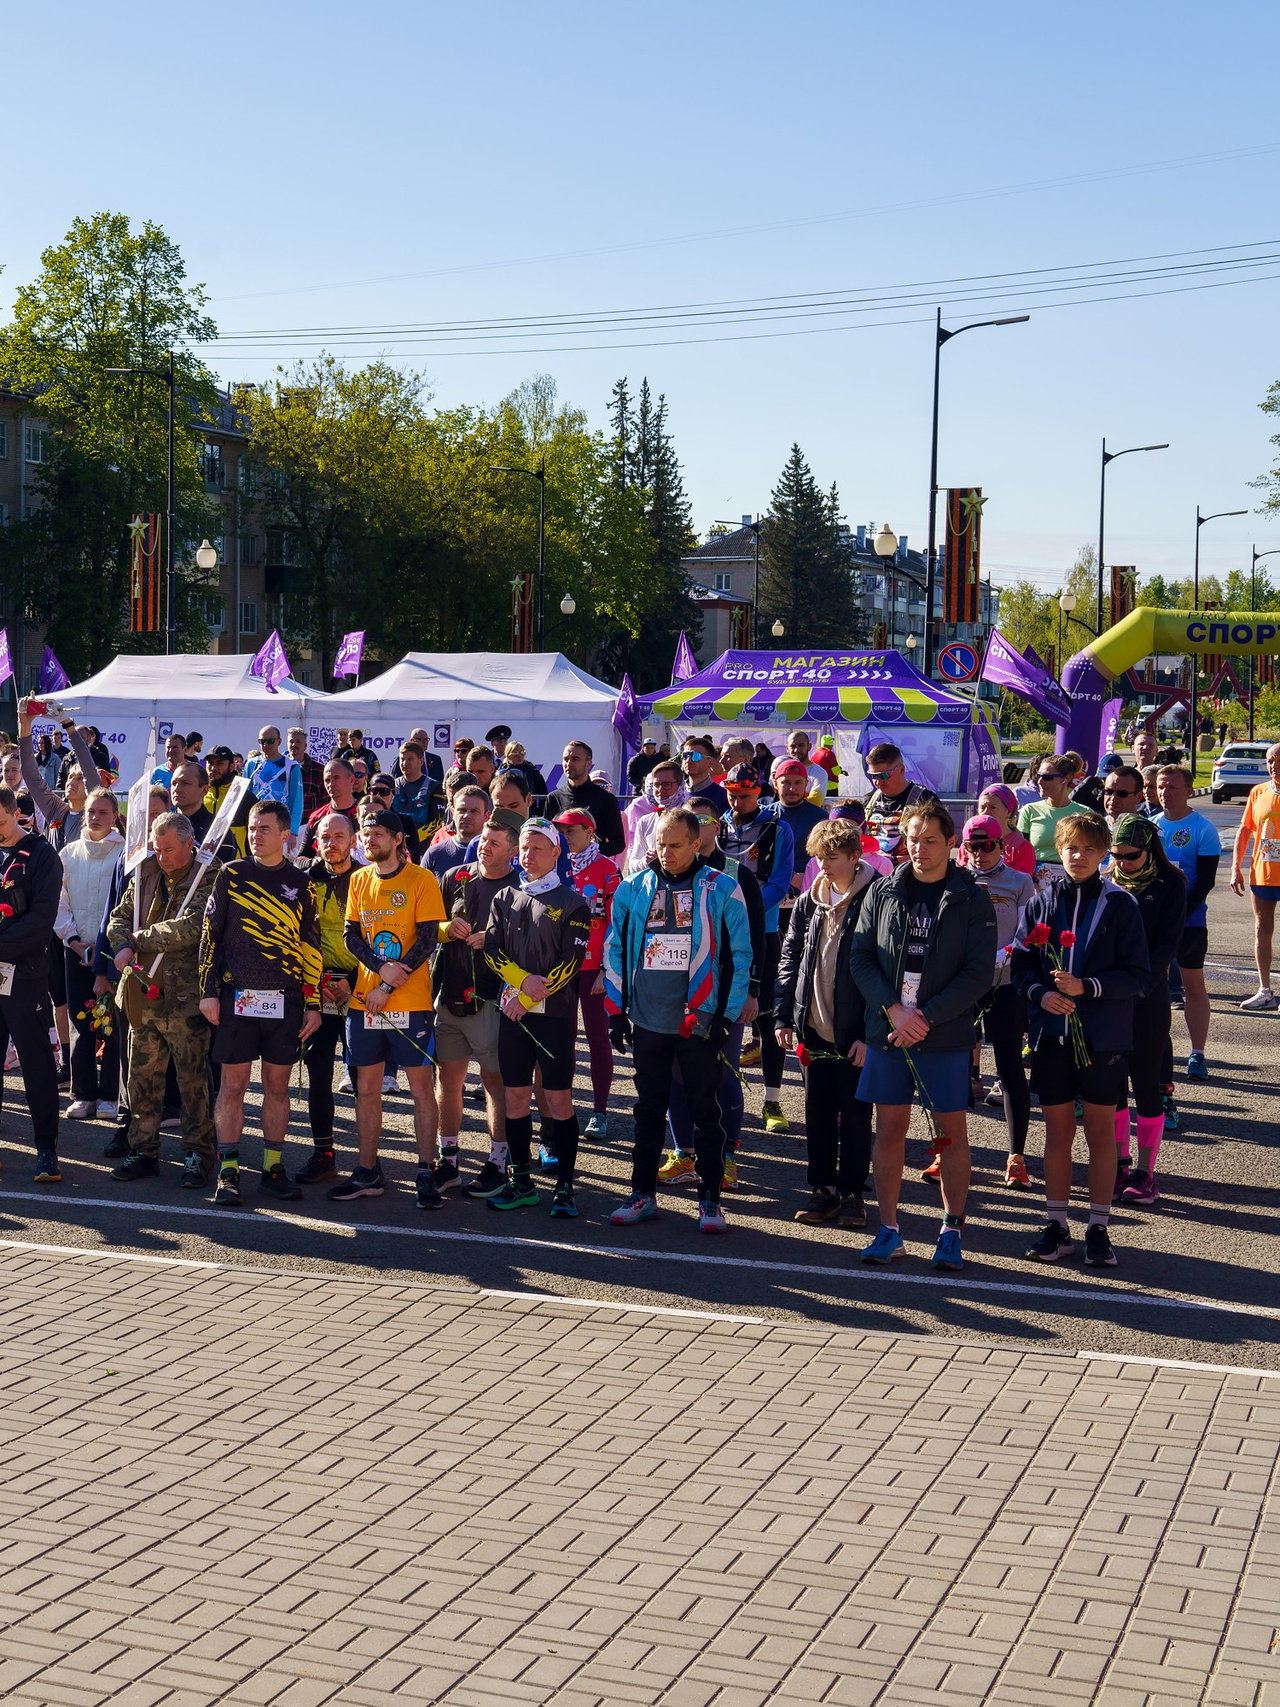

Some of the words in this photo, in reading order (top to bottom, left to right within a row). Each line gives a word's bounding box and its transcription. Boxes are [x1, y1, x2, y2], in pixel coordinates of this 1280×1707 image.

[1188, 612, 1227, 621] PRO
[1187, 622, 1280, 645] СПОР
[773, 656, 886, 669] МАГАЗИН
[723, 670, 799, 680] СПОРТ
[802, 670, 832, 680] 40
[108, 733, 126, 743] 40
[363, 737, 404, 748] ПОРТ
[668, 949, 688, 959] 118
